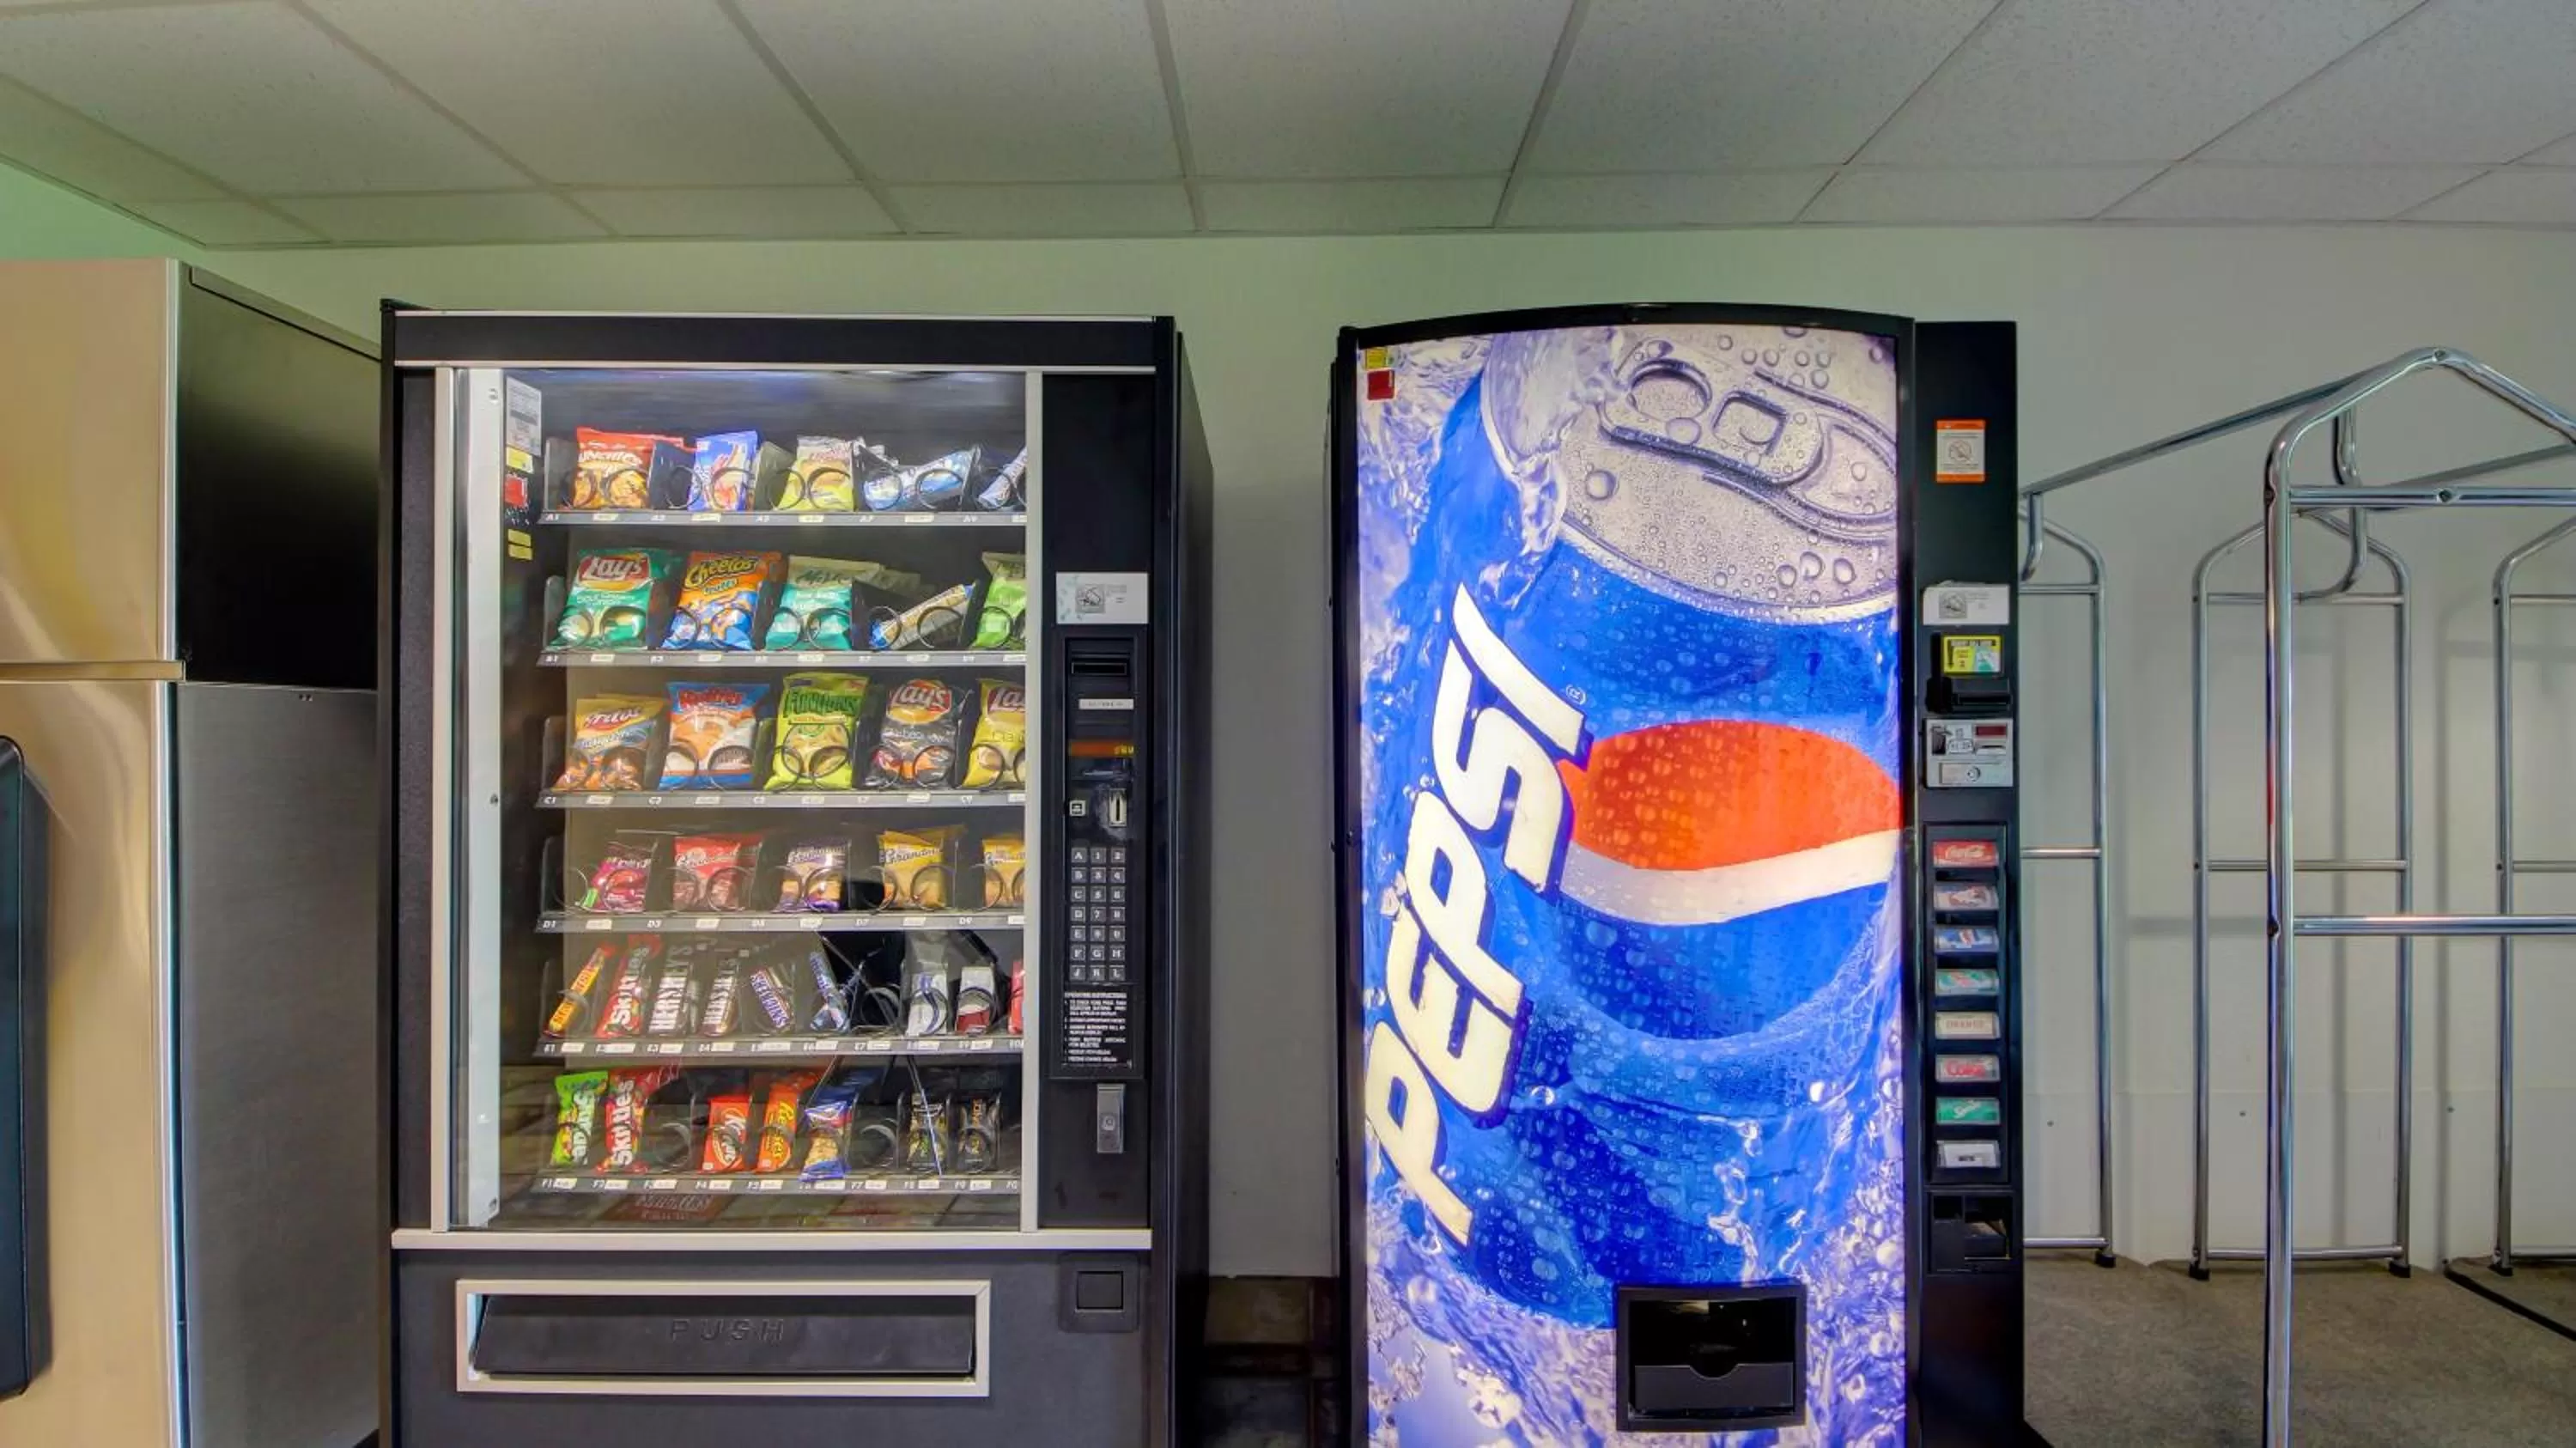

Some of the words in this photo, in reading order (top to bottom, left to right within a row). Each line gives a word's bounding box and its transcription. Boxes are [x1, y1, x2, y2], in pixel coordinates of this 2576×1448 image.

[684, 557, 759, 587] Cheetos
[1365, 581, 1585, 1248] PEPSI
[671, 1318, 785, 1342] PUSH
